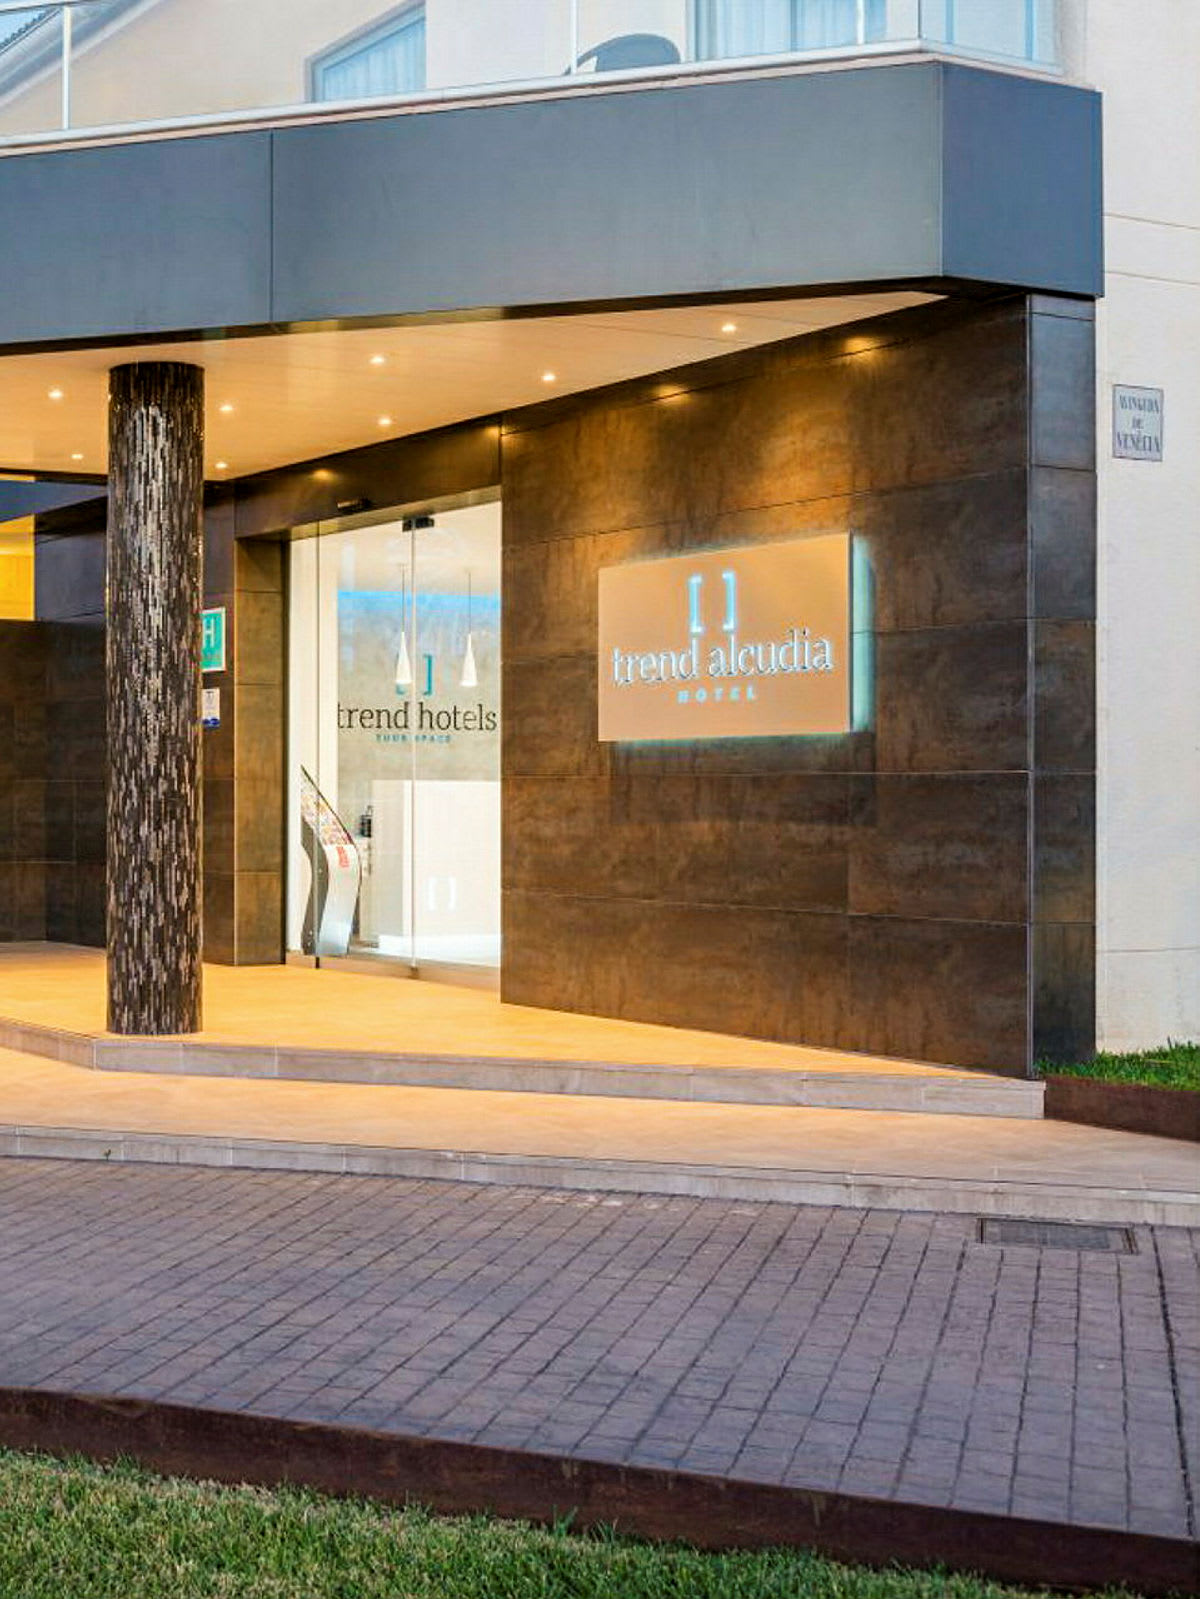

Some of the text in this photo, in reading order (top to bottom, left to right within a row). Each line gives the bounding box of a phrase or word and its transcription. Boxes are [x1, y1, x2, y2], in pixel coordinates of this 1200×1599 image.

[1131, 415, 1144, 430] DE
[611, 628, 834, 685] trend alcudia
[676, 685, 756, 704] HOTEL
[337, 701, 498, 731] trend hotels
